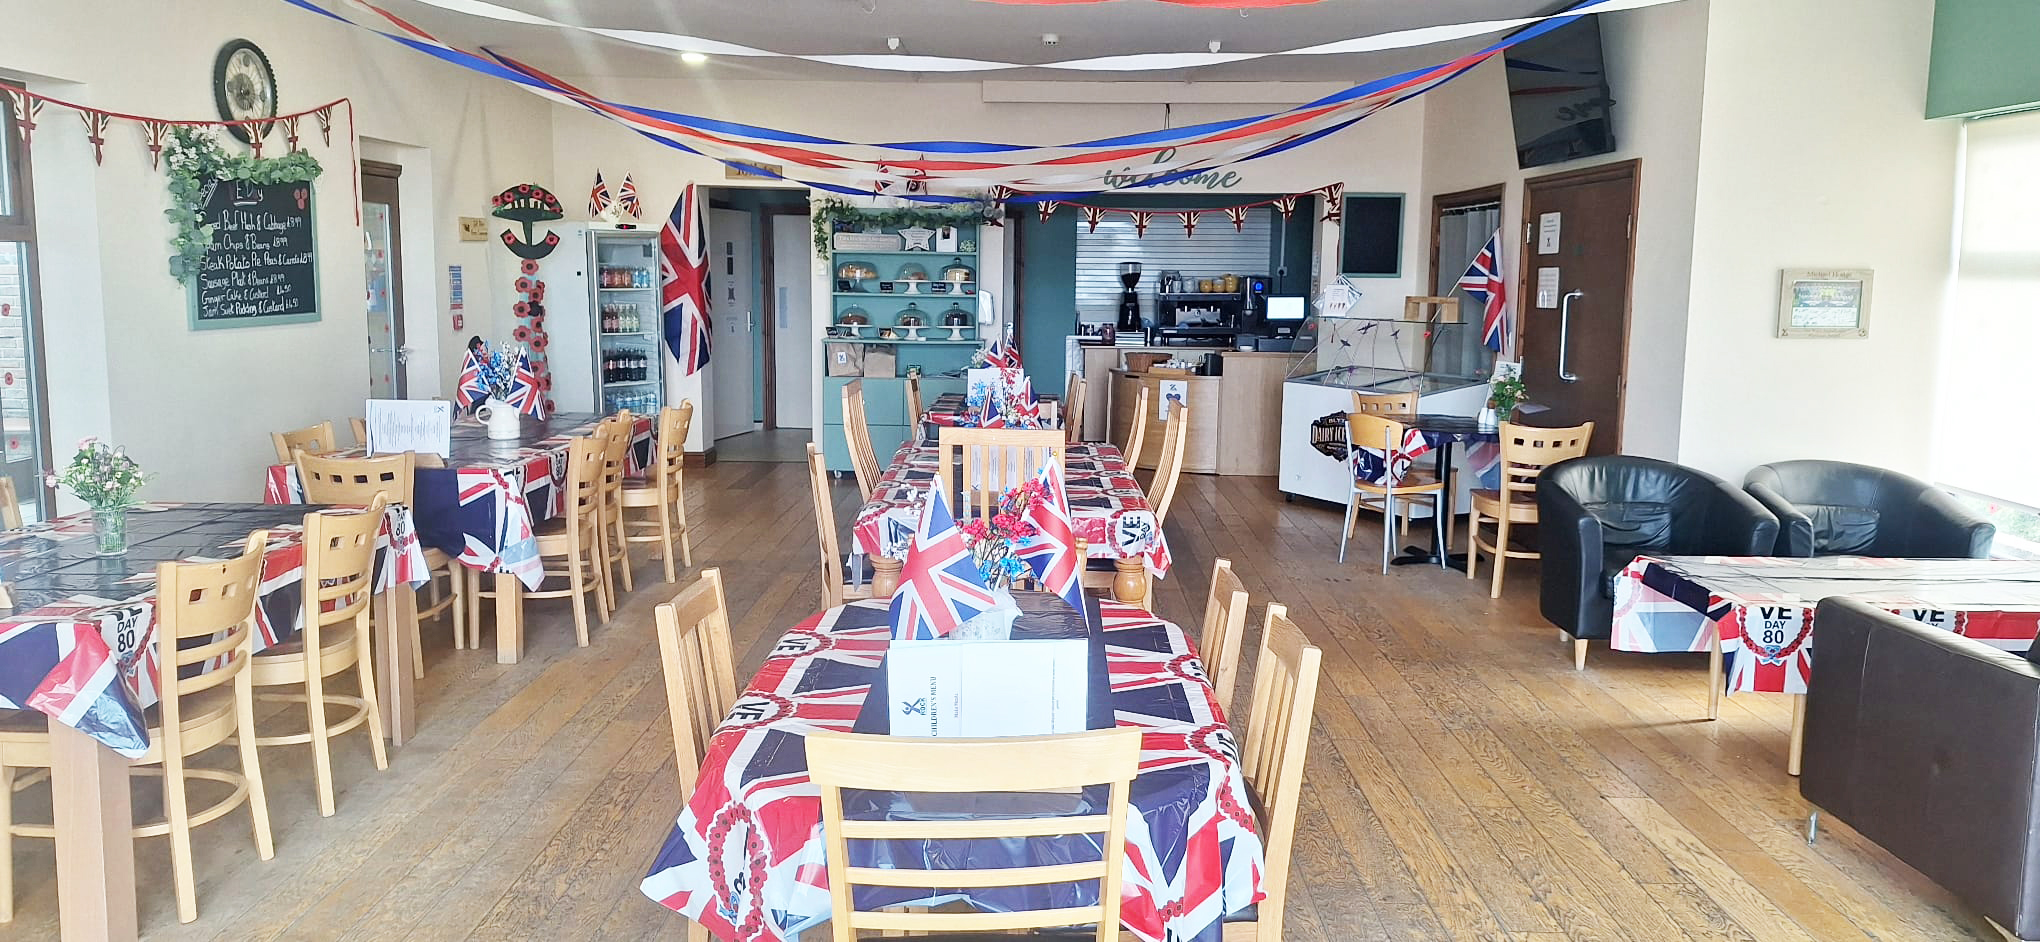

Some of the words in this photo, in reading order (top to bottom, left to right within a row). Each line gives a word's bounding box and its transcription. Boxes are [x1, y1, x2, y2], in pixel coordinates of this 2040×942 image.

[200, 255, 225, 271] Steak
[200, 273, 230, 294] Sausage
[1312, 425, 1334, 444] DAIRY
[1760, 606, 1792, 620] VE
[1912, 609, 1945, 622] VE
[117, 616, 139, 634] DAY
[1764, 620, 1786, 630] DAY
[117, 629, 135, 653] 80
[777, 637, 813, 651] VE
[1762, 629, 1784, 644] 80
[727, 702, 771, 721] VE
